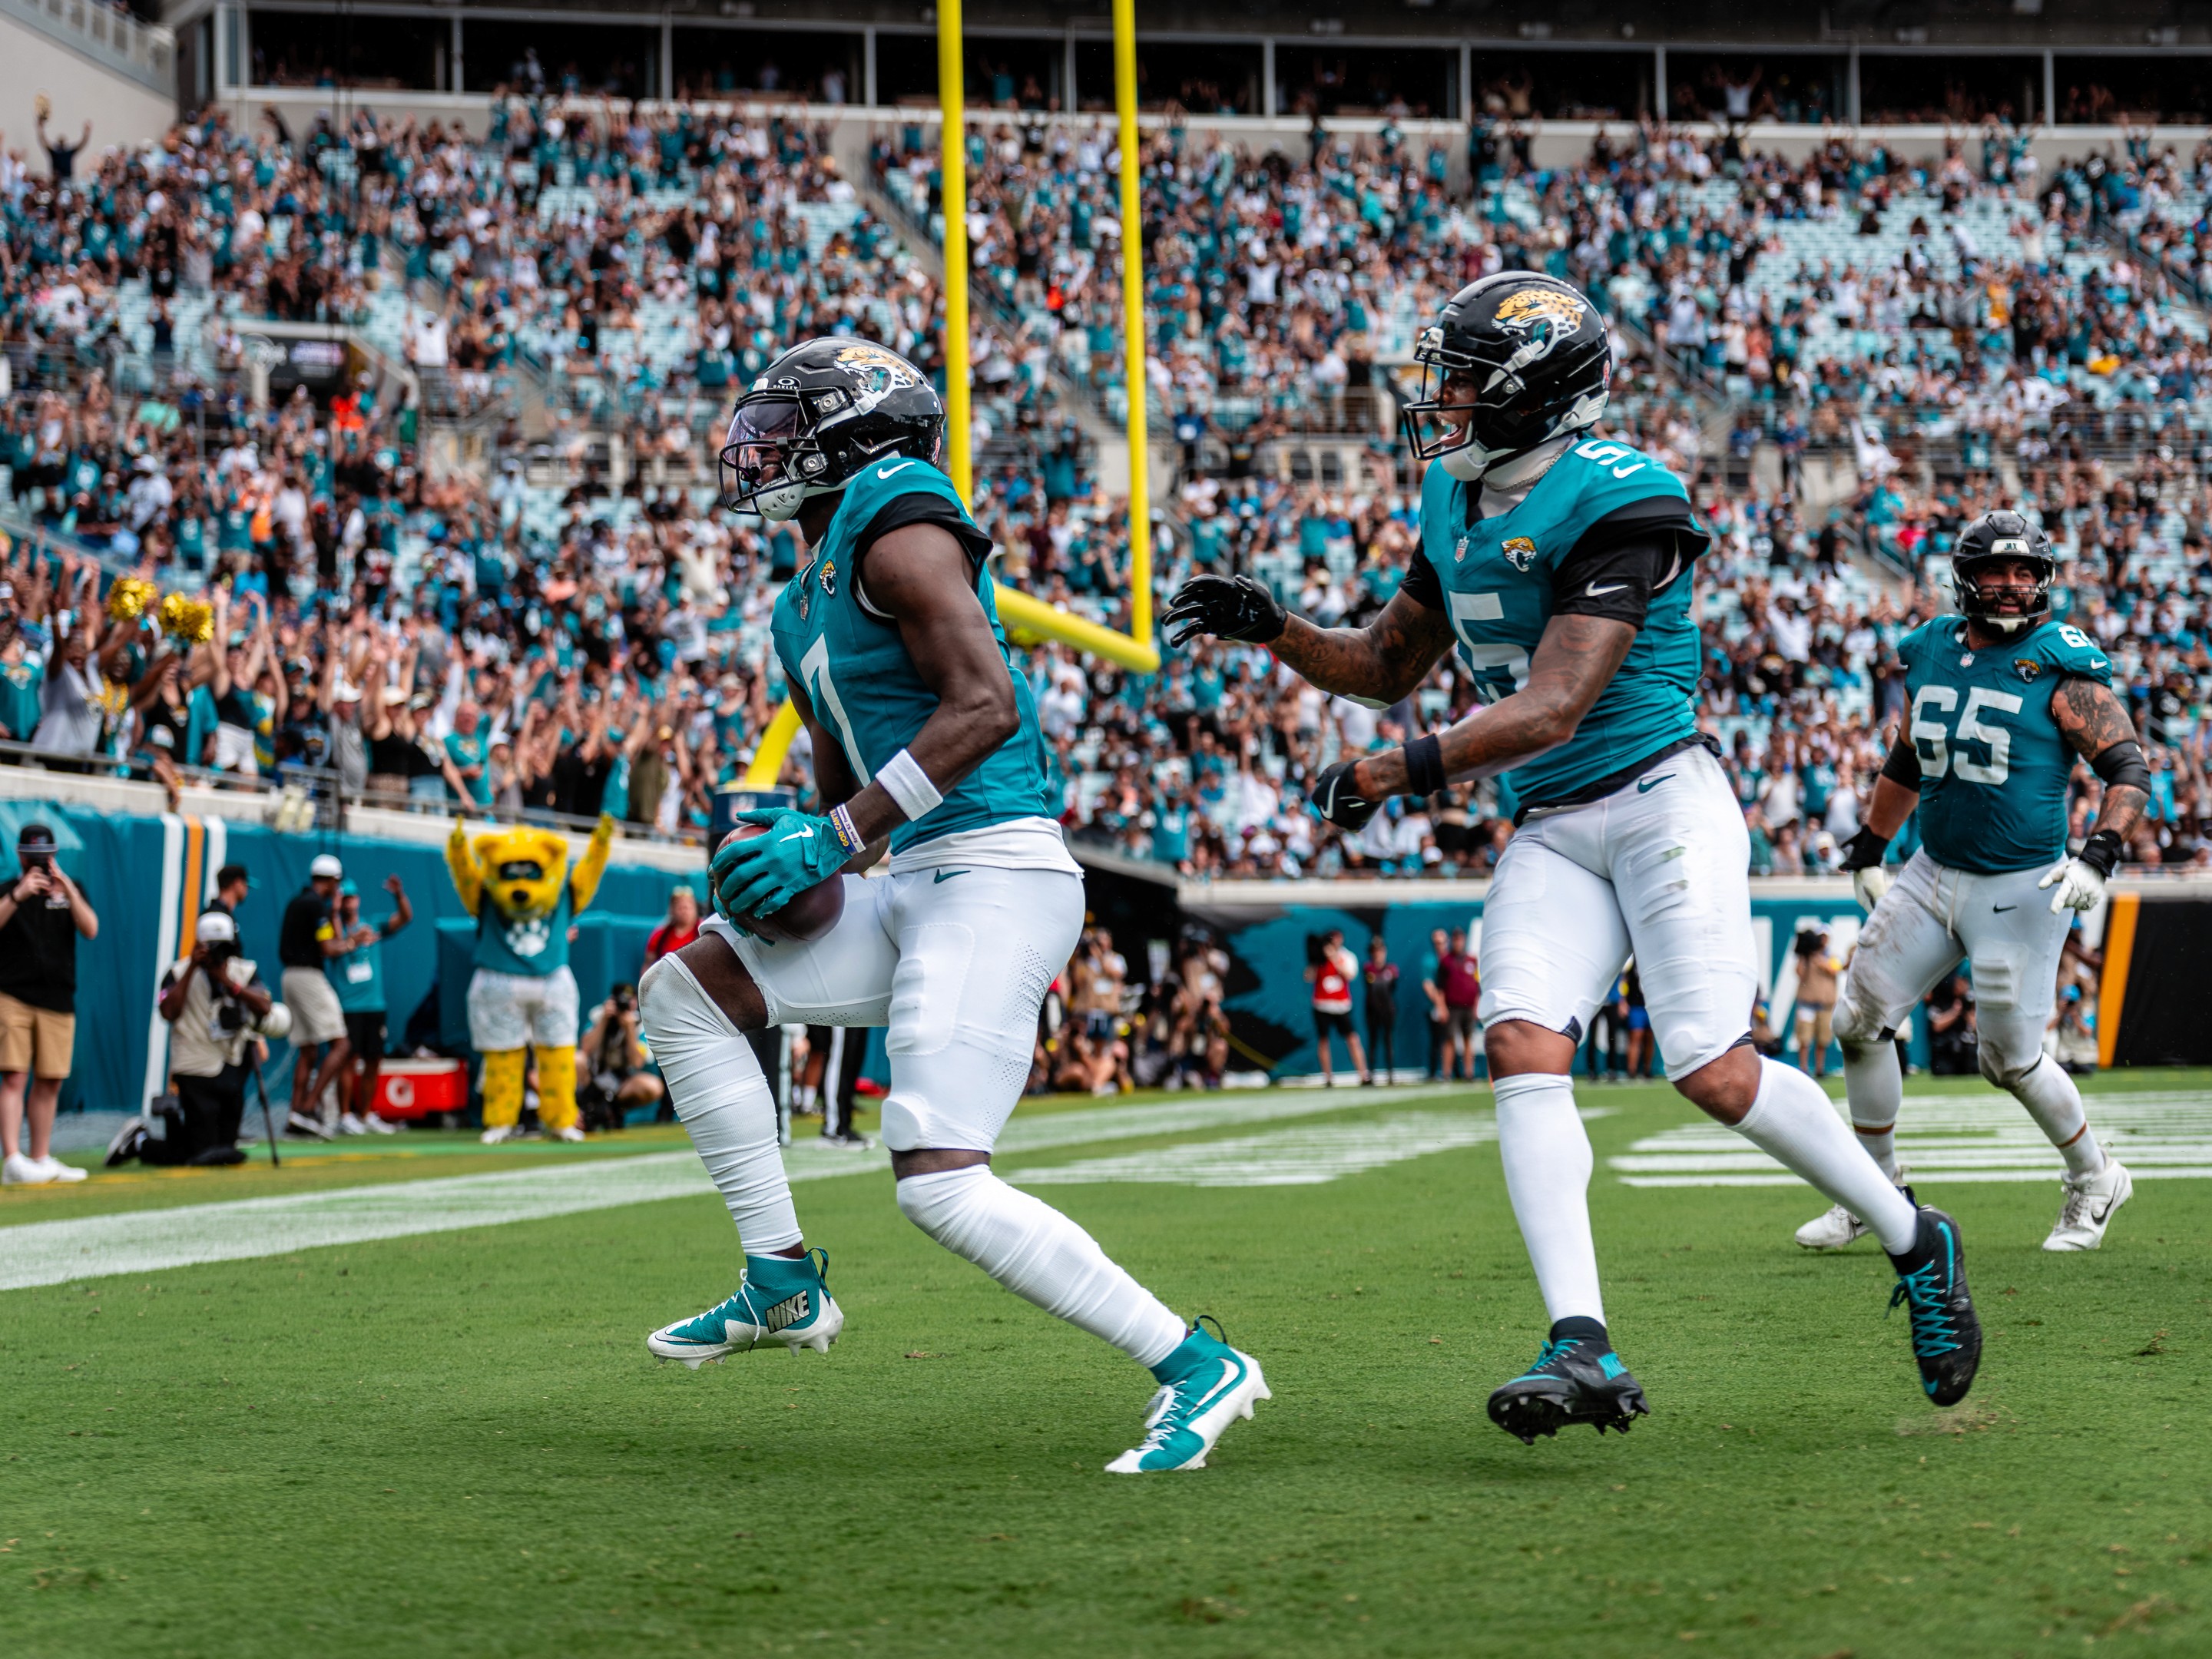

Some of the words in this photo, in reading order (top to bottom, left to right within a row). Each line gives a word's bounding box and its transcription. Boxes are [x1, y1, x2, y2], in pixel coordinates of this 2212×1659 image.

[1574, 440, 1631, 466] 5
[1448, 590, 1530, 702] 5
[800, 631, 871, 789] 7
[1909, 684, 2023, 785] 65
[838, 830, 849, 846] GOD
[766, 1290, 810, 1333] NIKE
